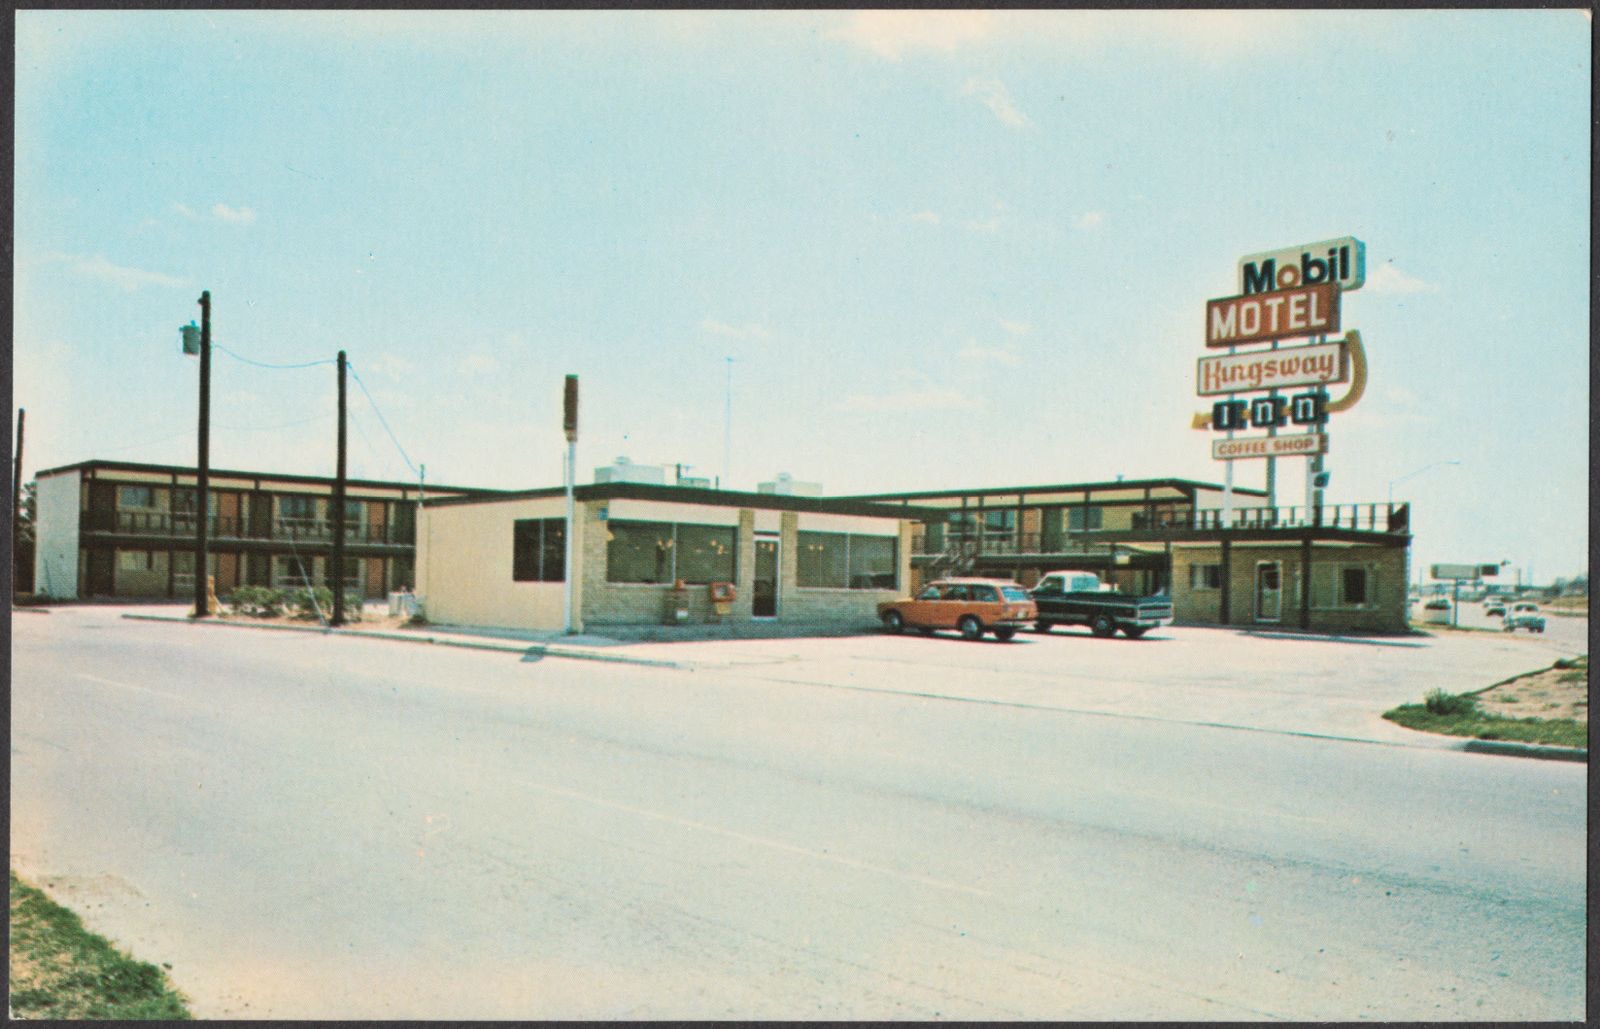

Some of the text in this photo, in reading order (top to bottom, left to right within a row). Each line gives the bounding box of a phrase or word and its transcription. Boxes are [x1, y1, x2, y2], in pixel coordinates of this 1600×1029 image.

[1243, 246, 1350, 294] Mobil
[1212, 292, 1326, 340] MOTEL
[1203, 352, 1334, 391] Kingsway
[1218, 439, 1314, 455] COFFEE SHOP
